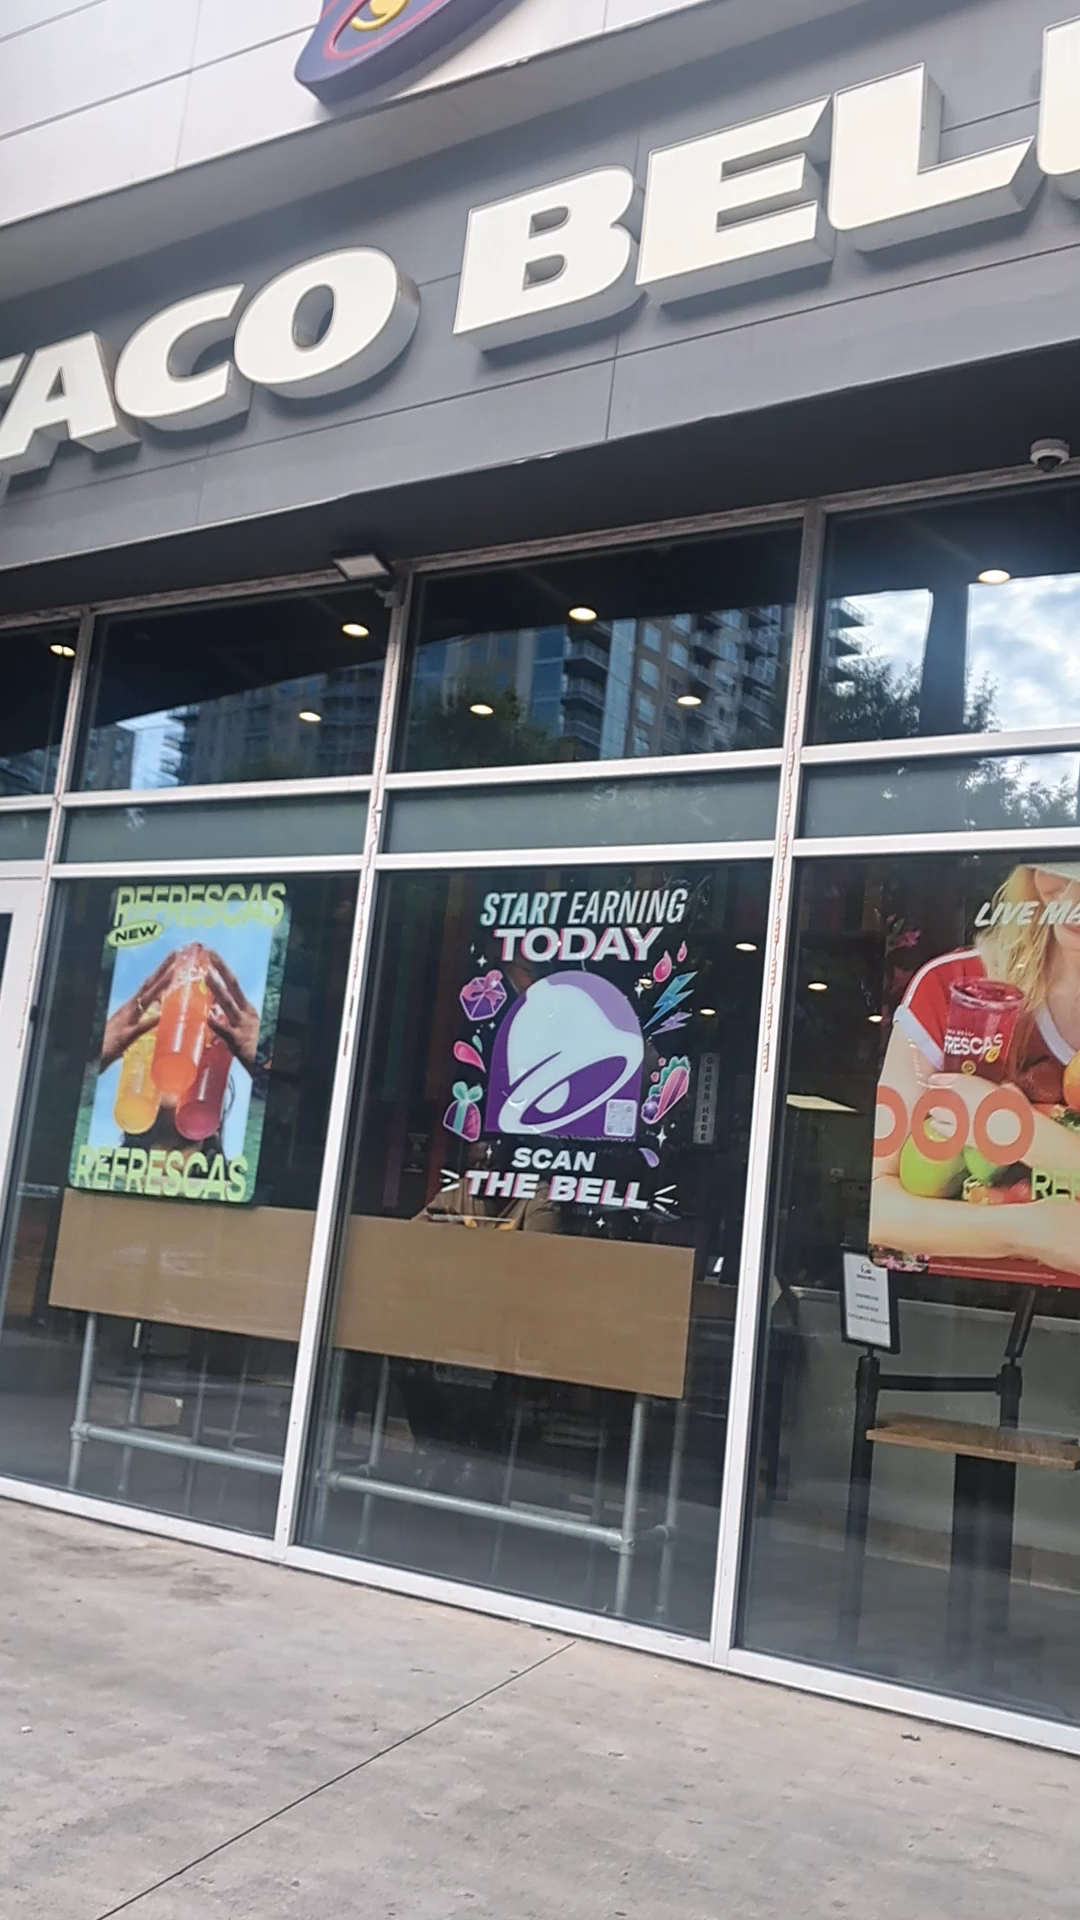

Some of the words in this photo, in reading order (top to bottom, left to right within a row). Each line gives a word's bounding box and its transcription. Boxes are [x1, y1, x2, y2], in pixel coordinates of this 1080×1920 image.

[480, 891, 567, 926] START
[567, 888, 688, 924] EARNING
[974, 901, 1039, 927] LIVE
[115, 924, 157, 942] NEW
[493, 926, 664, 962] TODAY
[700, 1106, 710, 1141] HERE
[74, 1144, 248, 1203] REFRESCAS
[511, 1147, 596, 1171] SCAN
[465, 1170, 540, 1199] THE
[548, 1175, 650, 1210] BELL
